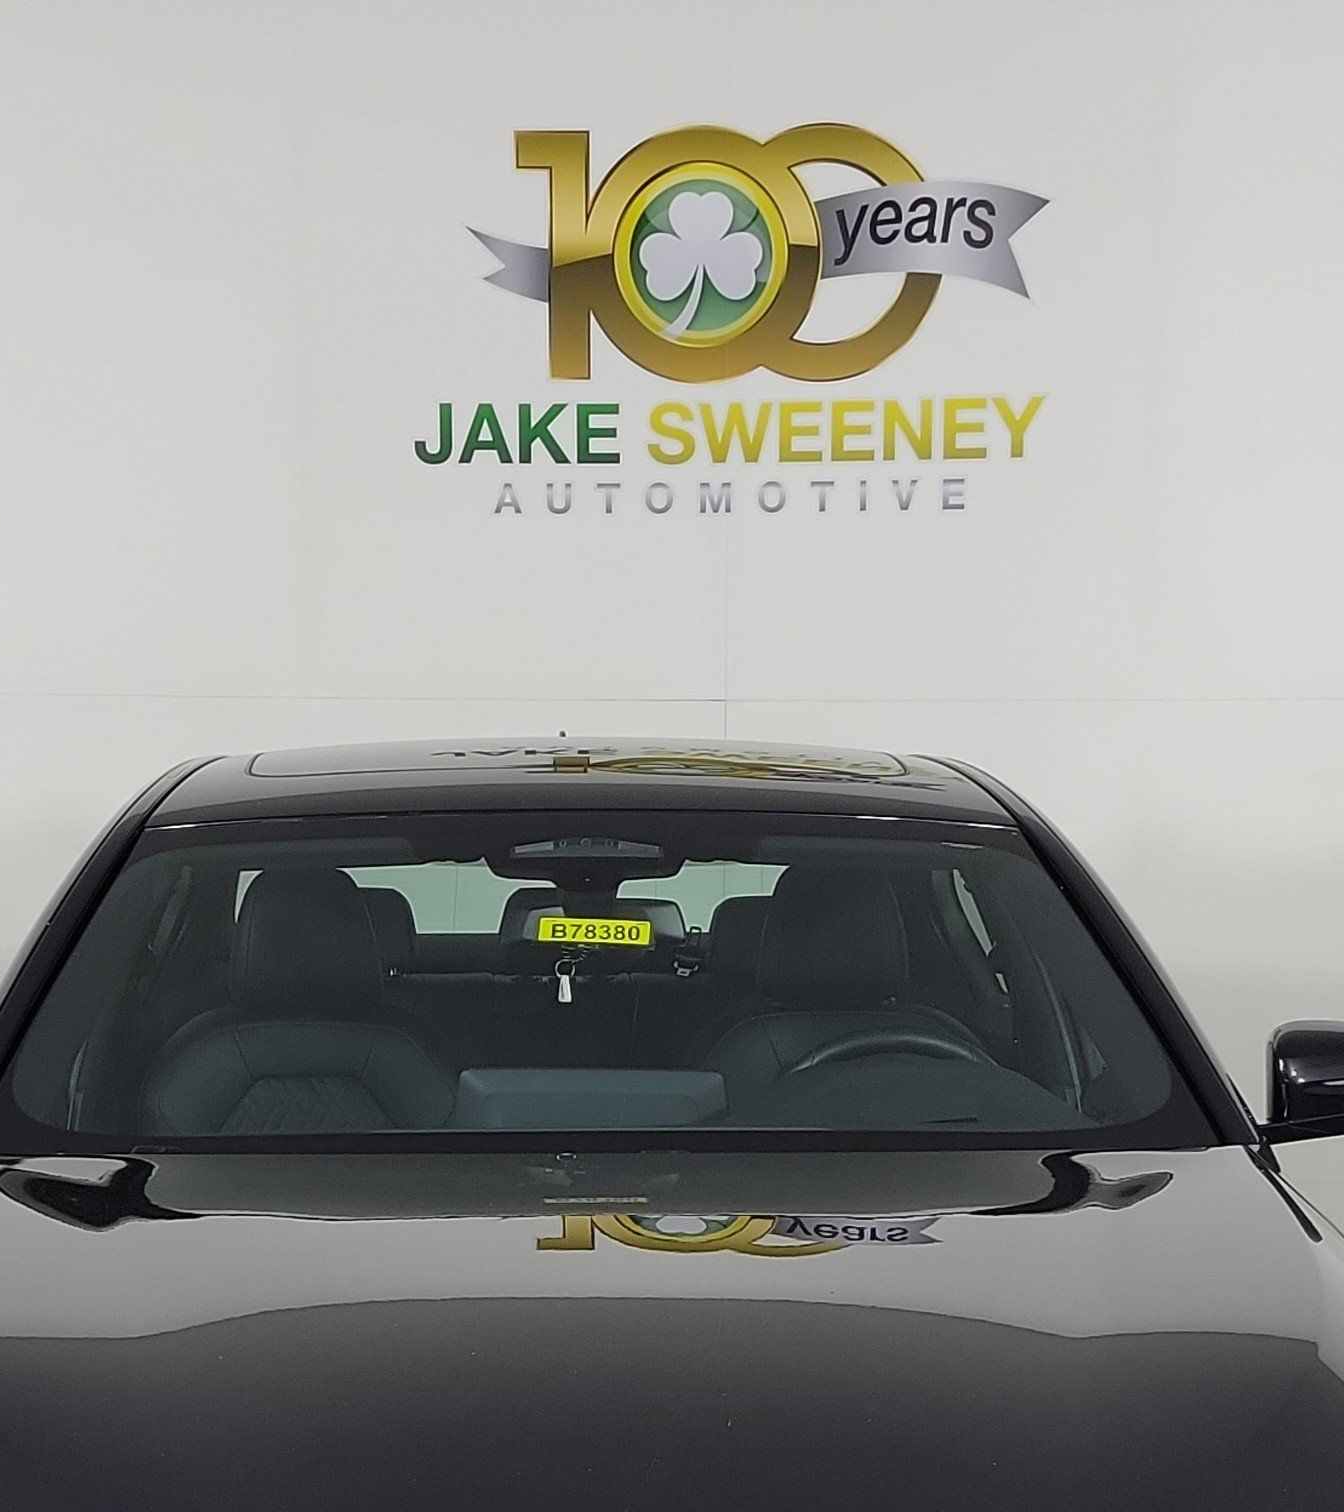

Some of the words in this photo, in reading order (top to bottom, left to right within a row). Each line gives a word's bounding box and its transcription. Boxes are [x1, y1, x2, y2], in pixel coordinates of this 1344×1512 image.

[513, 122, 943, 384] 100
[834, 195, 996, 267] years
[413, 402, 622, 466] JAKE
[646, 395, 1046, 465] SWEENEY
[494, 477, 967, 515] AUTOMOTIVE
[550, 922, 642, 943] B78380
